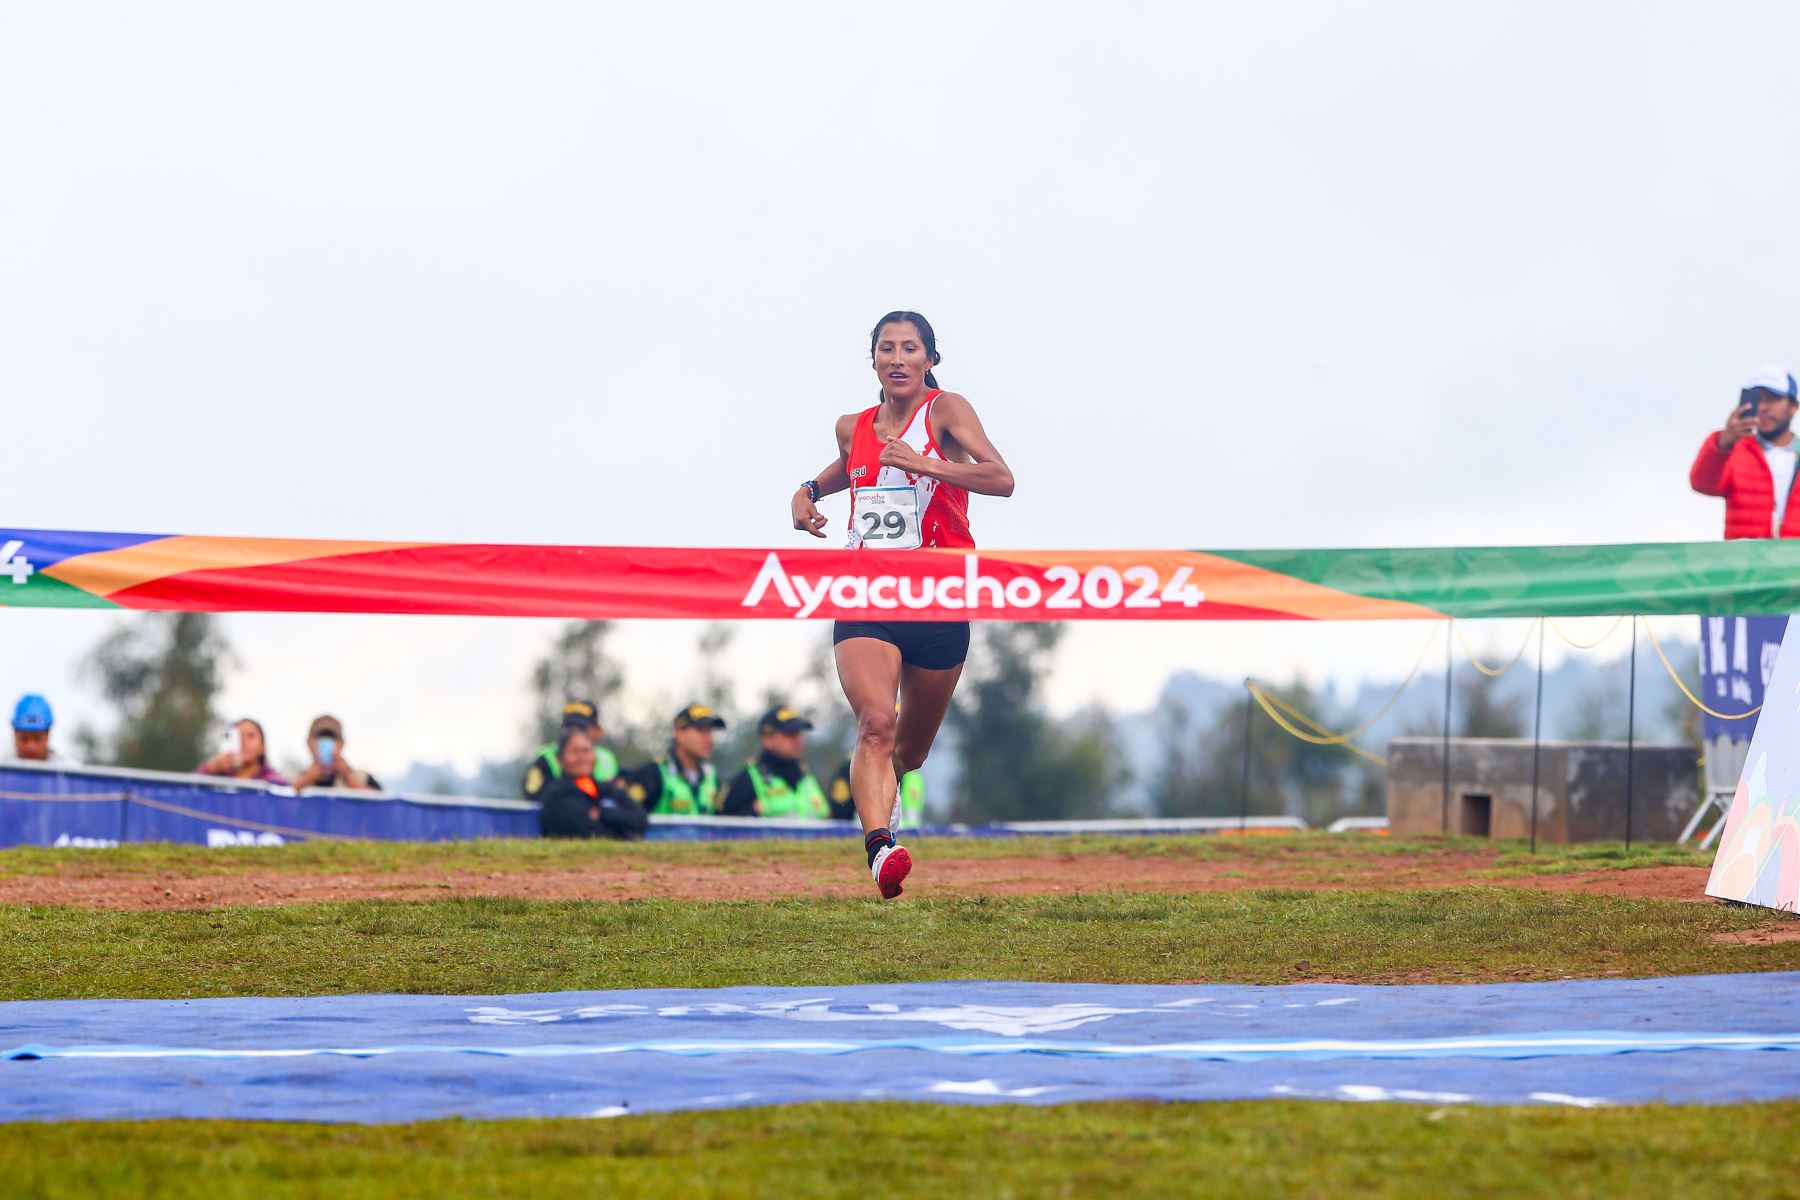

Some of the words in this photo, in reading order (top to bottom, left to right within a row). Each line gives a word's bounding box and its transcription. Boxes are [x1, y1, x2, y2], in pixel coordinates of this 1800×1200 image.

[861, 511, 906, 540] 29
[741, 552, 1041, 618] Ayacucho
[1044, 565, 1205, 609] 2024
